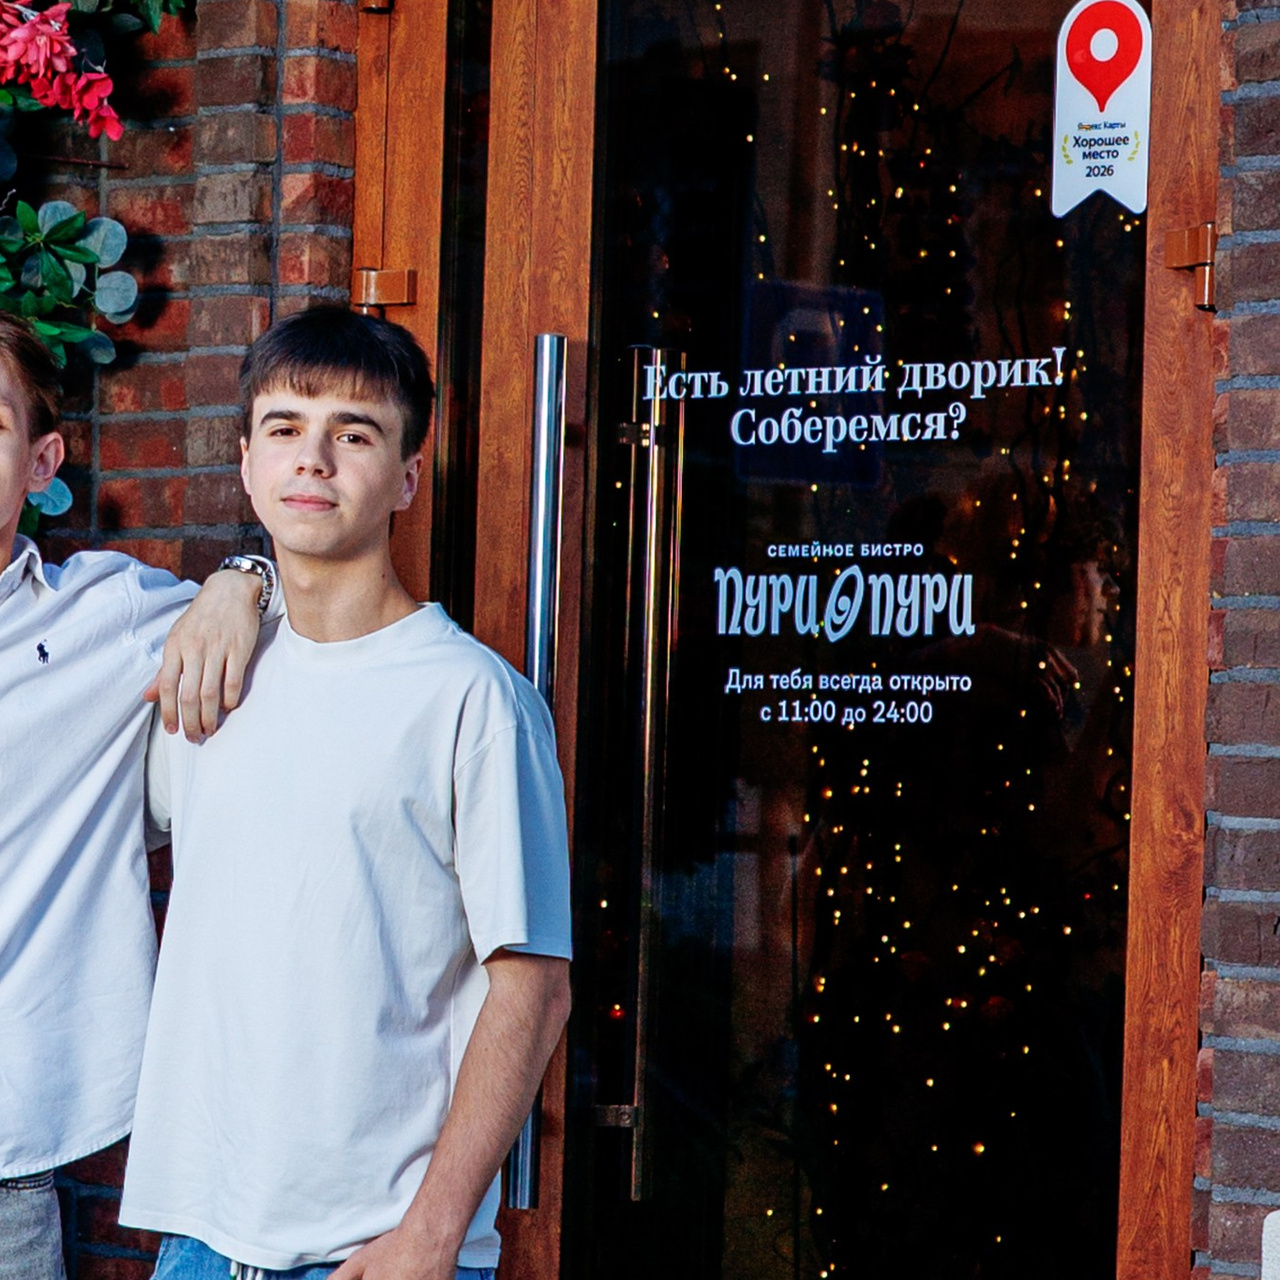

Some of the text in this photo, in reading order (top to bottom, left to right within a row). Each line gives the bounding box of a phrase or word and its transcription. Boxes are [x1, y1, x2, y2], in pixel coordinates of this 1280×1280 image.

[1072, 135, 1130, 149] Хорошее
[1082, 149, 1119, 160] место
[1085, 164, 1114, 178] 2026
[642, 346, 1067, 400] Есть летний дворик!
[731, 401, 967, 454] Соберемся?
[767, 540, 924, 557] СЕМЕЙНОЕ БИСТРО
[724, 668, 972, 696] Для тебя всегда открыто
[759, 700, 933, 726] с 11:00 до 24:00
